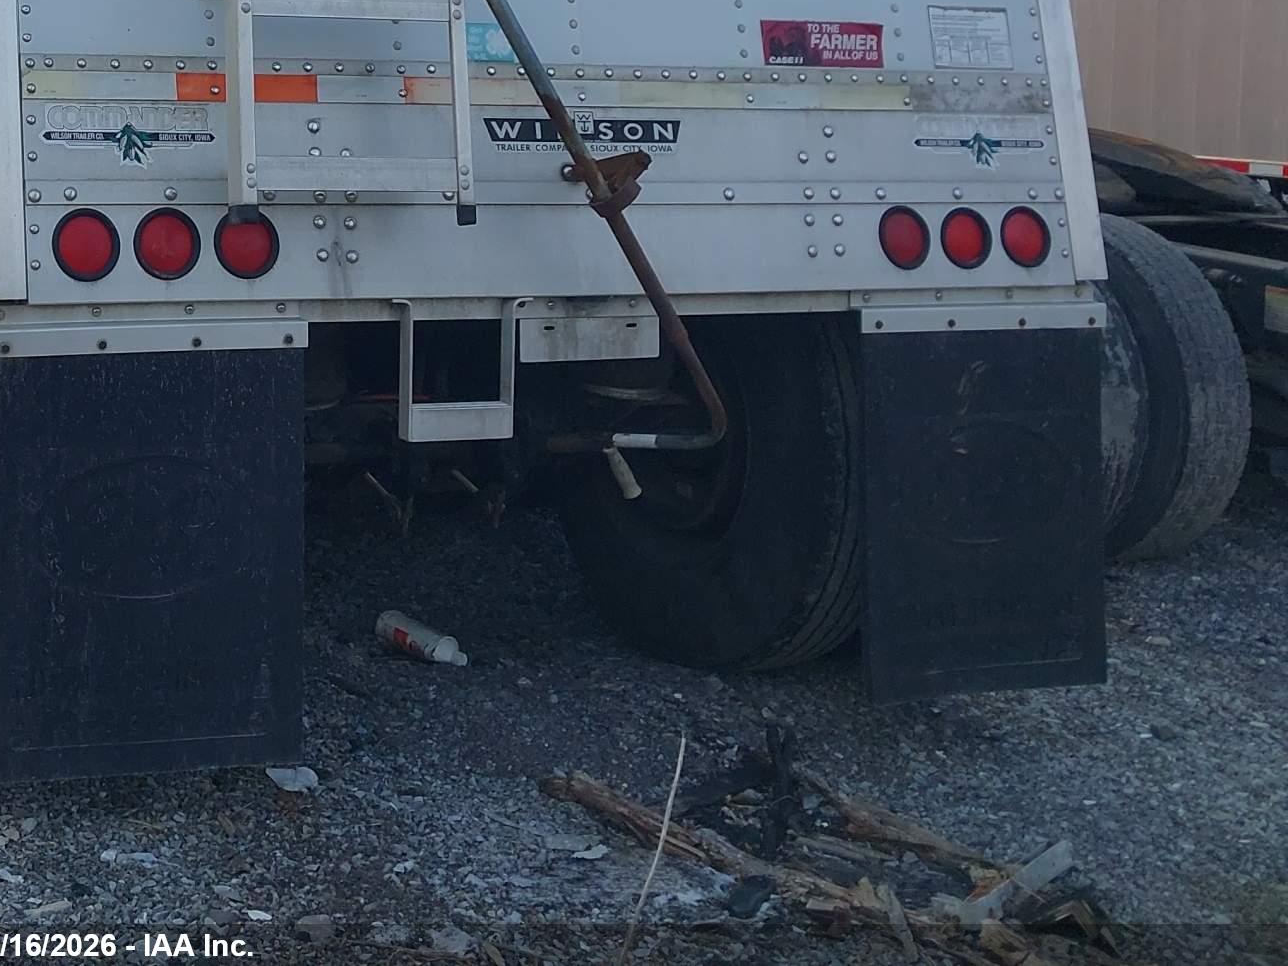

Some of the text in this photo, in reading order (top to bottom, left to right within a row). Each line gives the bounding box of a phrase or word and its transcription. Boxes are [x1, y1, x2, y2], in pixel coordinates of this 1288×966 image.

[807, 23, 841, 34] TO THE
[810, 33, 879, 51] FARMER
[823, 50, 879, 61] IN ALL OF US
[50, 132, 72, 141] WILSON
[72, 132, 95, 141] TRAILER
[490, 121, 674, 141] WISON
[158, 133, 178, 141] SIOUX
[496, 144, 531, 152] TRAILER
[590, 144, 618, 153] SIOUX
[647, 145, 673, 153] IOWA
